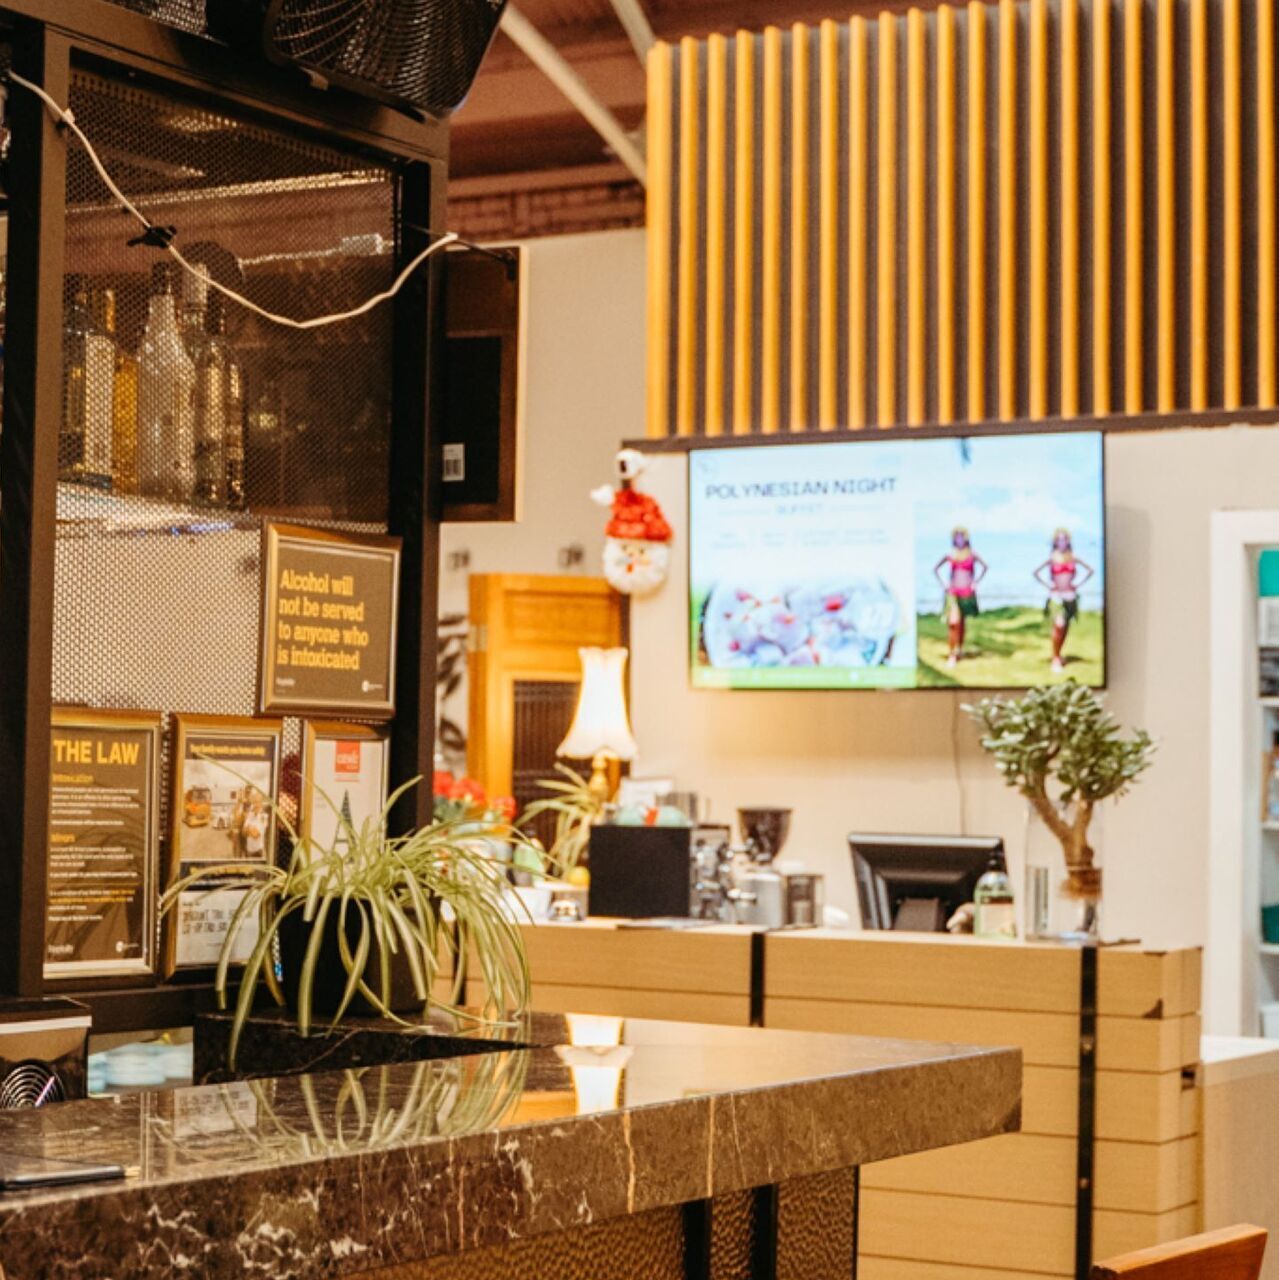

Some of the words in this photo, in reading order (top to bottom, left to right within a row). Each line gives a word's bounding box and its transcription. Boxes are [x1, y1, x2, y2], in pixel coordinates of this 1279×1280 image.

[705, 481, 828, 499] POLYNESIAN
[833, 477, 896, 495] NIGHT
[280, 569, 329, 593] Alcohol
[332, 575, 354, 596] will
[278, 596, 300, 615] not
[303, 596, 319, 617] be
[322, 601, 364, 622] served
[278, 620, 291, 641] to
[294, 625, 340, 646] anyone
[342, 626, 369, 646] who
[277, 644, 288, 664] is
[290, 645, 360, 670] intoxicated
[53, 739, 92, 763] THE
[96, 741, 139, 765] LAW
